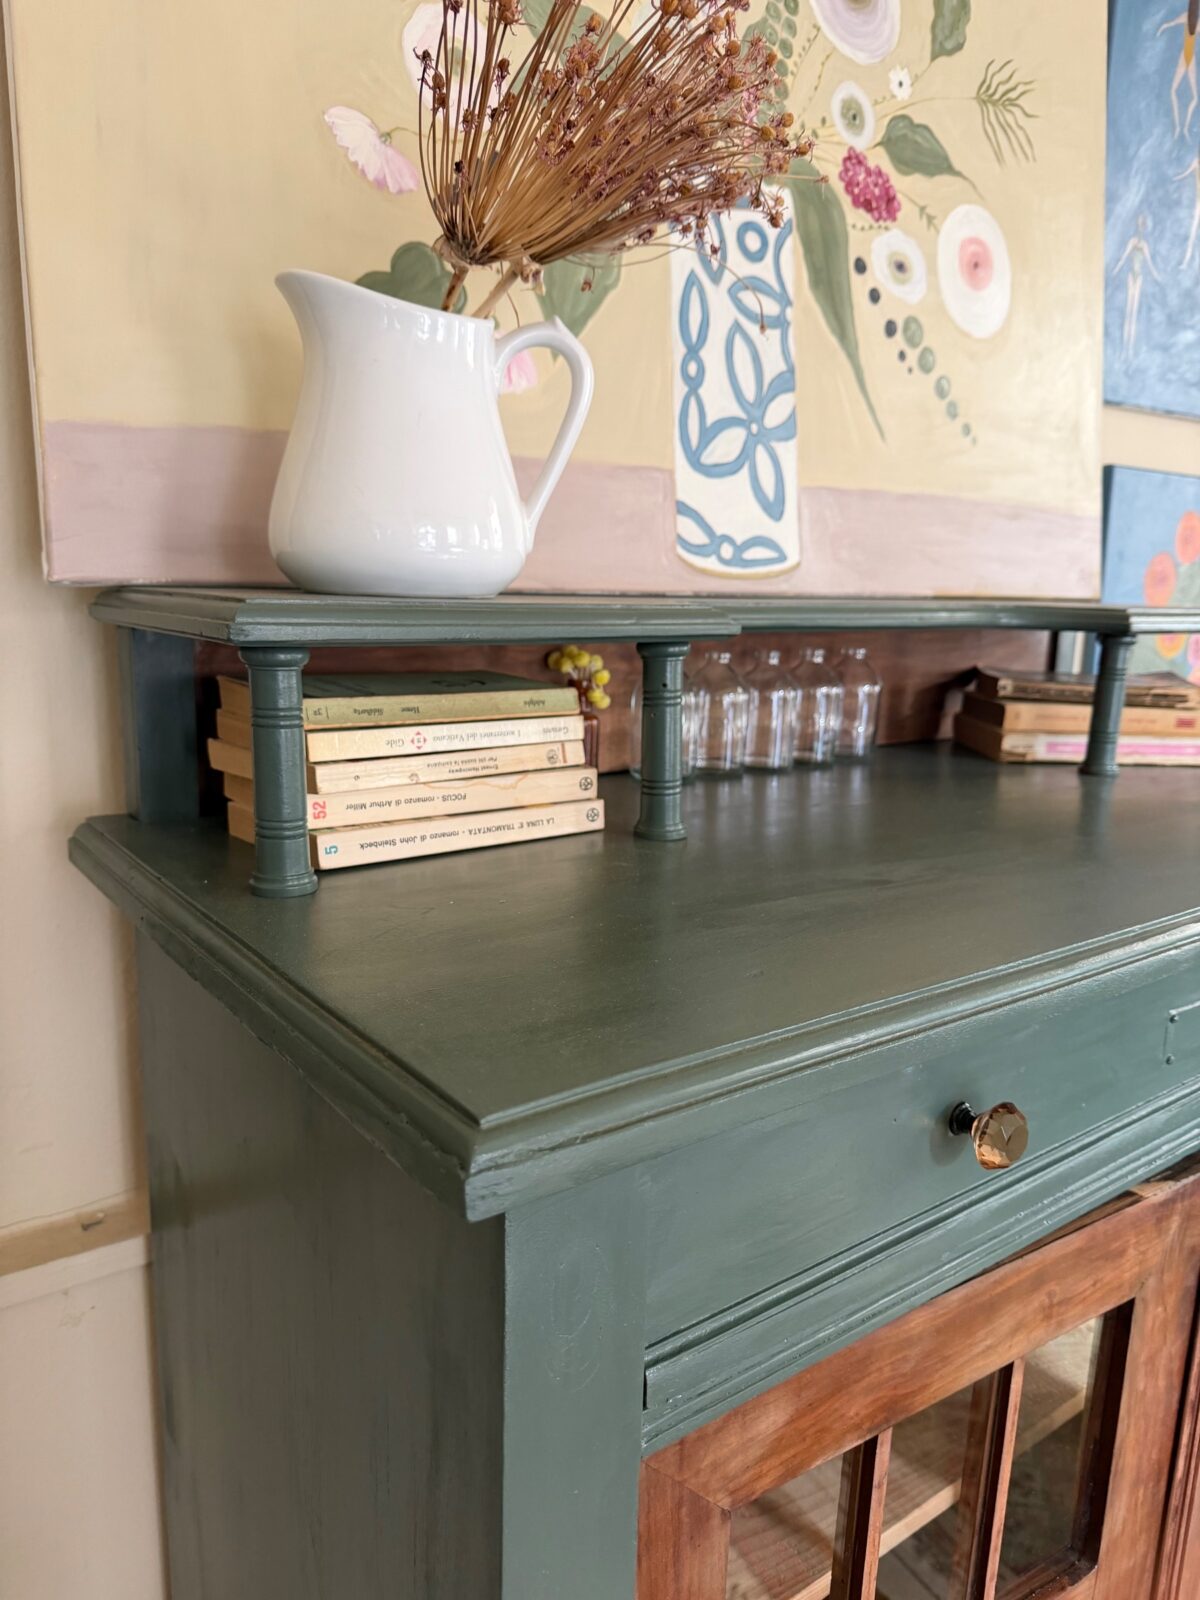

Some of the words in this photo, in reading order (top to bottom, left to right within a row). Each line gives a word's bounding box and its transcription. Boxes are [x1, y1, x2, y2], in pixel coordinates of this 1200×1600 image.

[384, 738, 405, 748] Gide
[404, 796, 435, 804] romanzo
[441, 793, 467, 802] FOCUS
[345, 802, 367, 811] Miller
[369, 800, 393, 809] Arthur
[395, 799, 402, 807] di
[312, 801, 327, 820] 52
[526, 819, 544, 828] LUNA
[546, 817, 554, 825] LA
[468, 823, 515, 834] TRAMONTATA
[420, 834, 427, 843] di
[429, 830, 459, 840] romanzo
[359, 838, 397, 850] Steinbeck
[399, 835, 417, 846] John
[324, 845, 339, 855] 5
